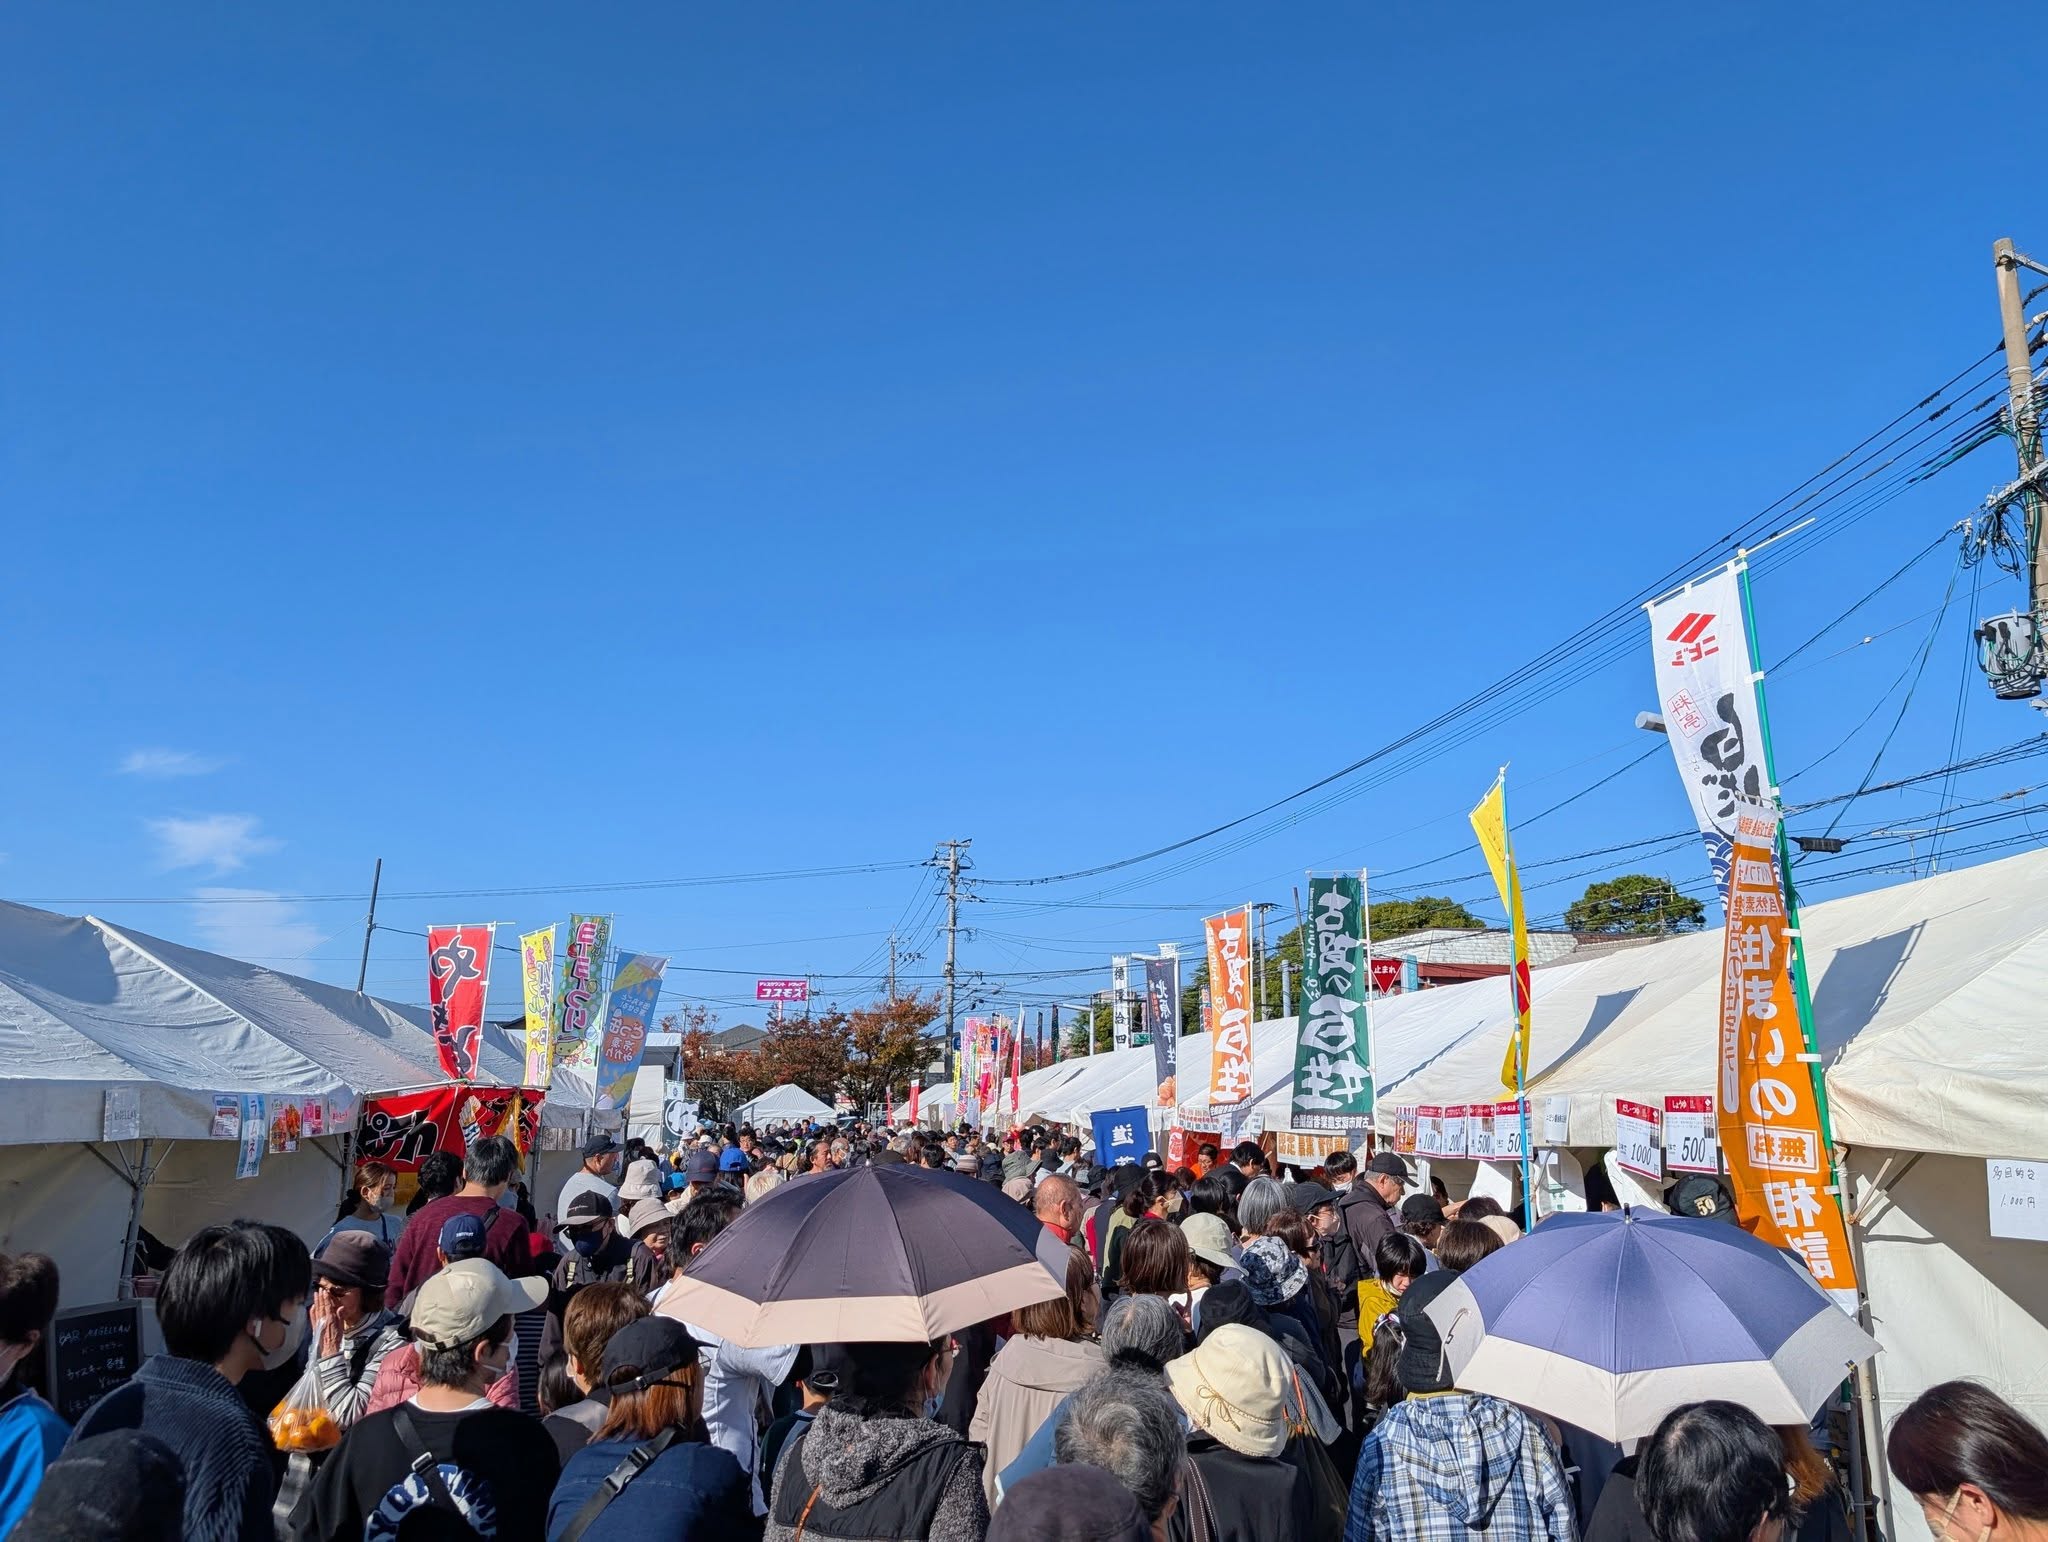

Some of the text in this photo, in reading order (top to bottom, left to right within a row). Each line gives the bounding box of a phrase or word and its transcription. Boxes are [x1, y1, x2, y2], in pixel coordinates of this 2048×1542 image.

[1374, 965, 1396, 974] 止まれ
[1424, 1132, 1436, 1150] 100
[1682, 1137, 1705, 1163] 500
[1631, 1143, 1652, 1166] 1000
[1694, 1195, 1716, 1216] 59
